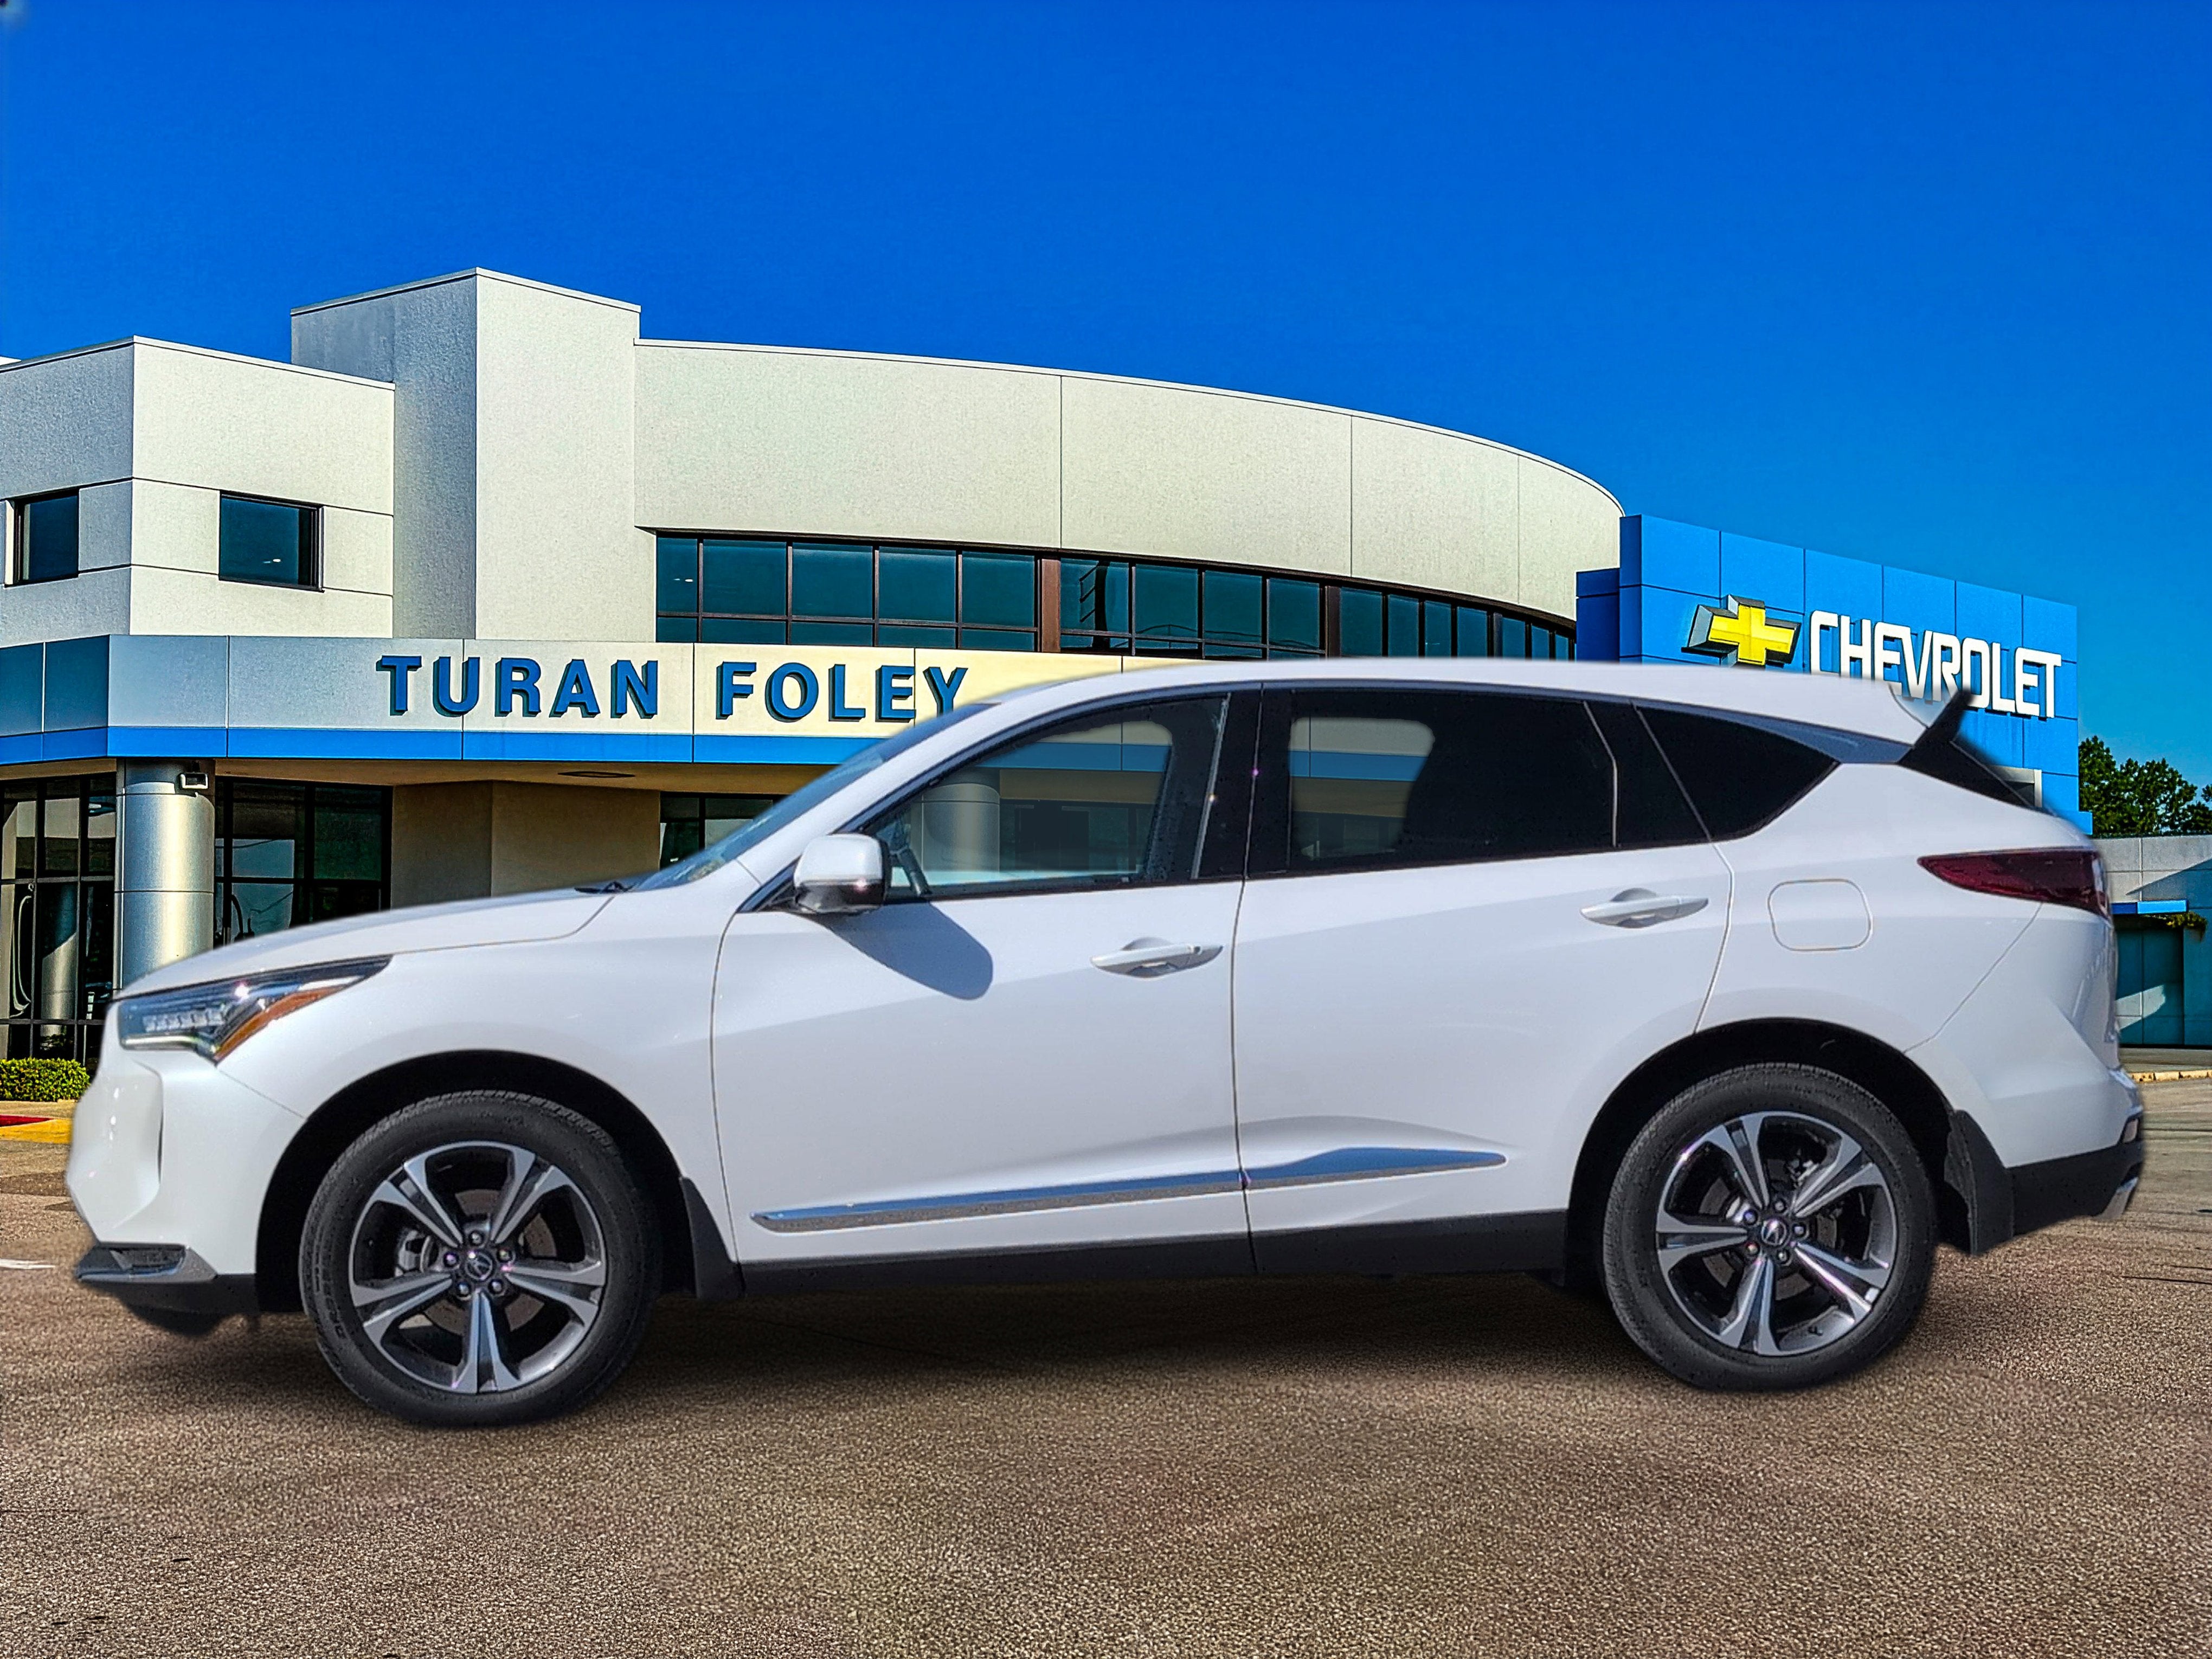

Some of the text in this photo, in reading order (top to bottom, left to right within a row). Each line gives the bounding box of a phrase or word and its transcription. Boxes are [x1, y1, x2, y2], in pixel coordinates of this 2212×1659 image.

[376, 655, 969, 723] TURAN FOLEY
[1810, 610, 2061, 718] CHEVROLET
